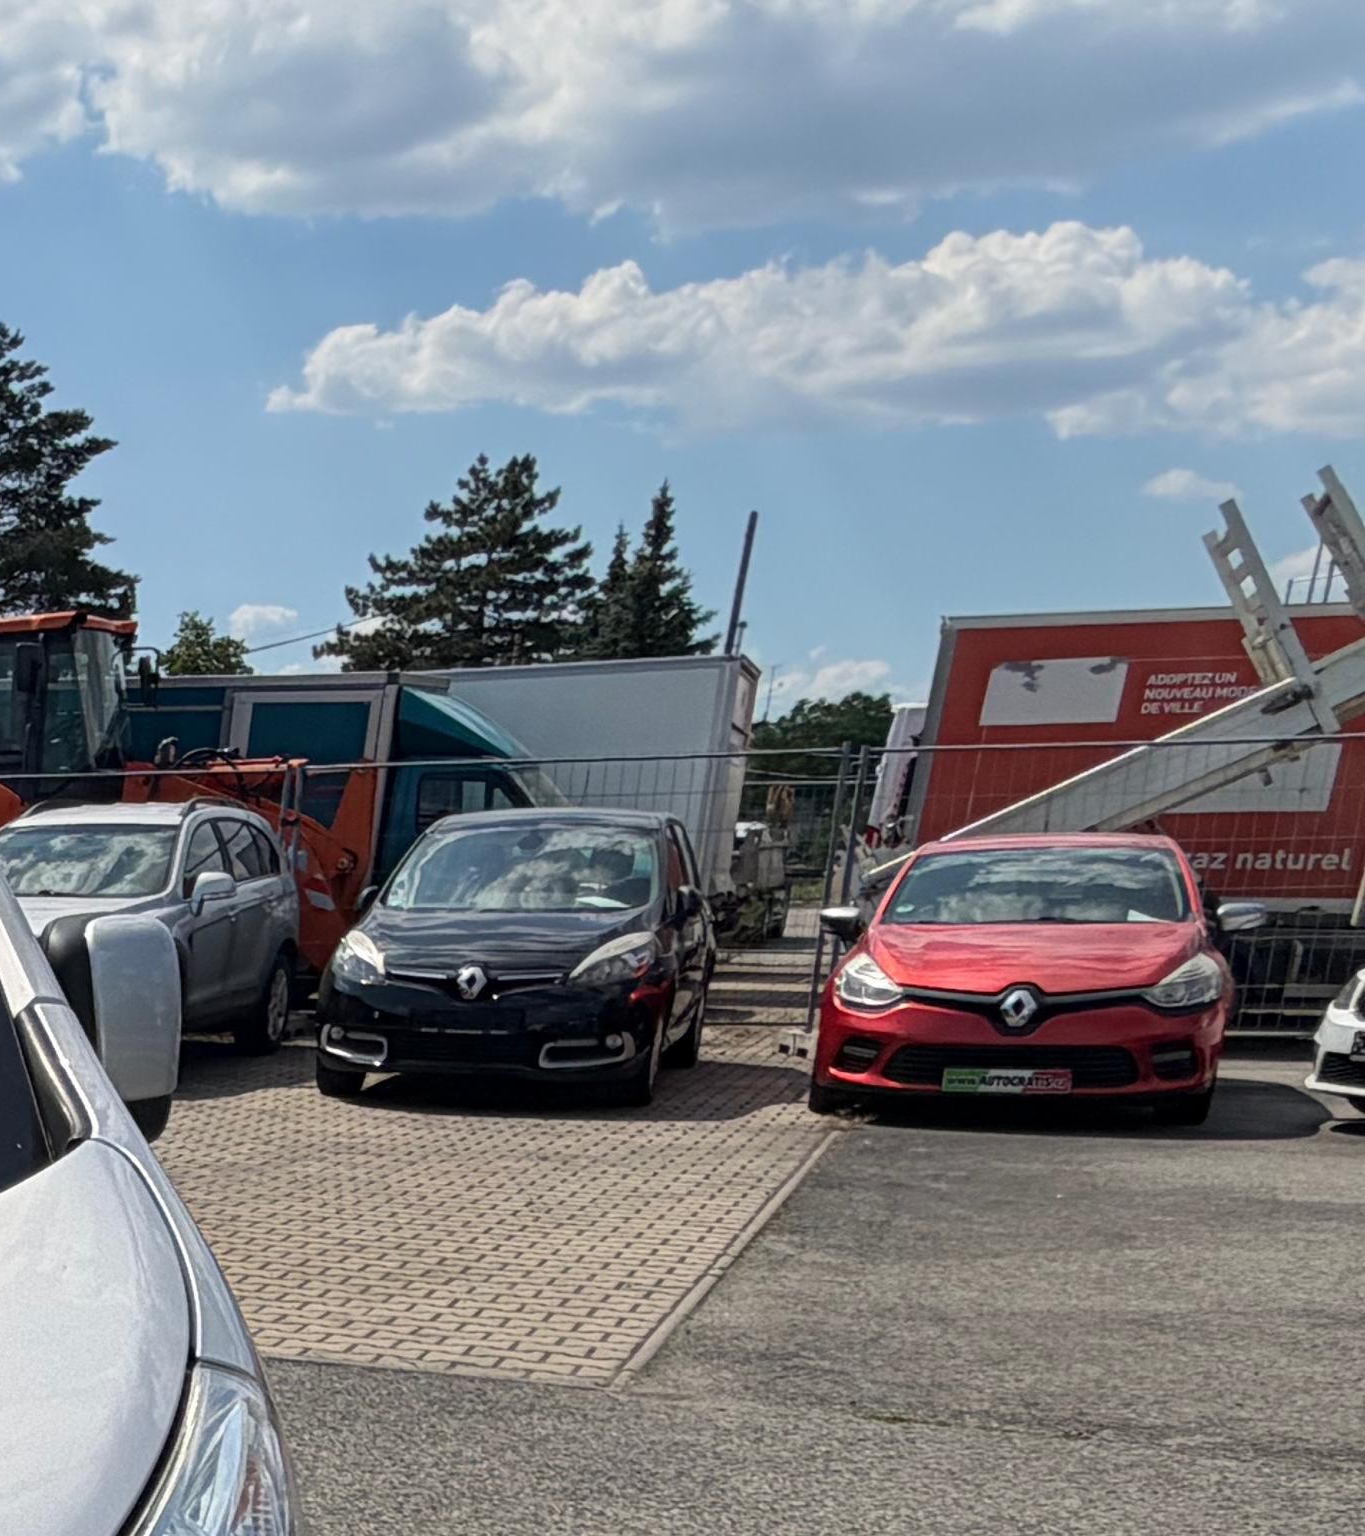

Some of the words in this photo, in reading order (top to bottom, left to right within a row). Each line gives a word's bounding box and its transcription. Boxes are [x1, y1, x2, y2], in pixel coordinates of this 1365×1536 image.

[1146, 673, 1213, 685] ADOPTEZ
[1215, 672, 1237, 683] UN
[1144, 687, 1213, 700] NOUVEAU
[1141, 703, 1161, 714] DE
[1163, 701, 1204, 713] VILLE
[1186, 852, 1228, 869] az
[1235, 848, 1352, 871] naturel
